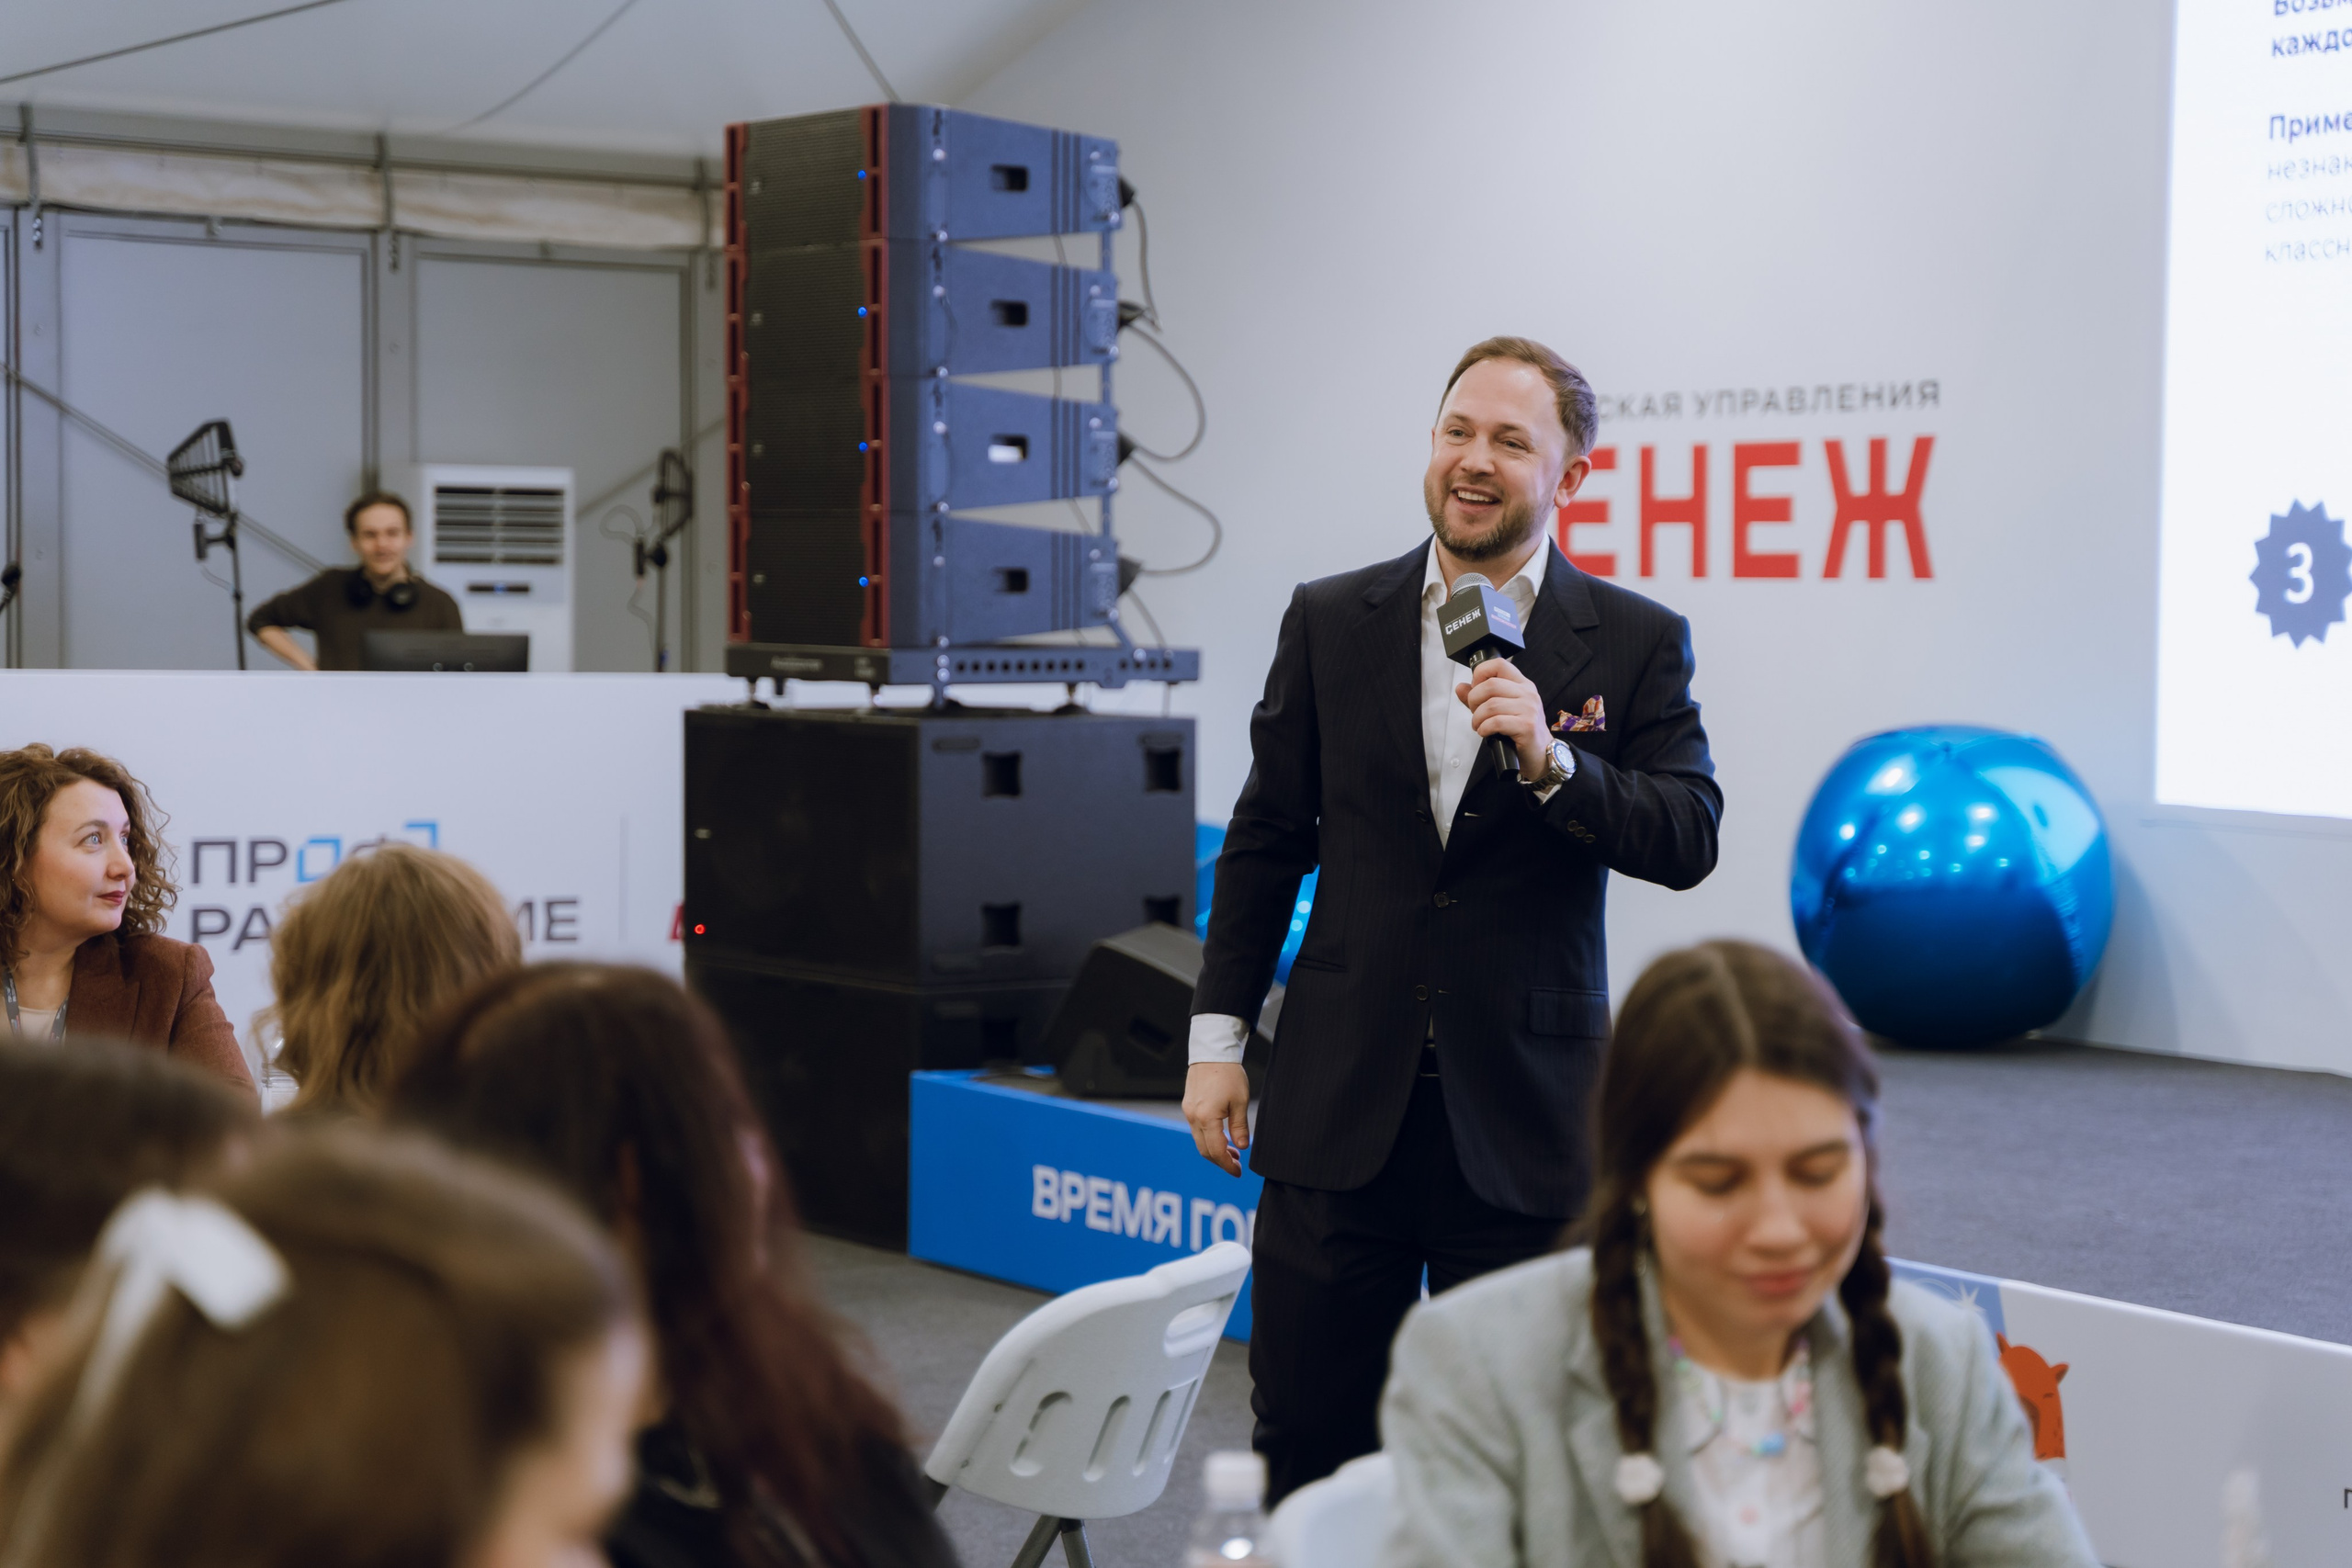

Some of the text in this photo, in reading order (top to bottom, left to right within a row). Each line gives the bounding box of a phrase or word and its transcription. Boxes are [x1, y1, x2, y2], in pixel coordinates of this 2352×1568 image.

[2266, 197, 2352, 223] сложн
[1597, 378, 1941, 422] СКАЯ УПРАВЛЕНИЯ
[1557, 434, 1936, 580] ЕНЕЖ
[2285, 542, 2314, 604] 3
[1444, 608, 1482, 636] СЕНЕЖ
[191, 833, 413, 886] ПРО
[1031, 1163, 1182, 1249] ВРЕМЯ
